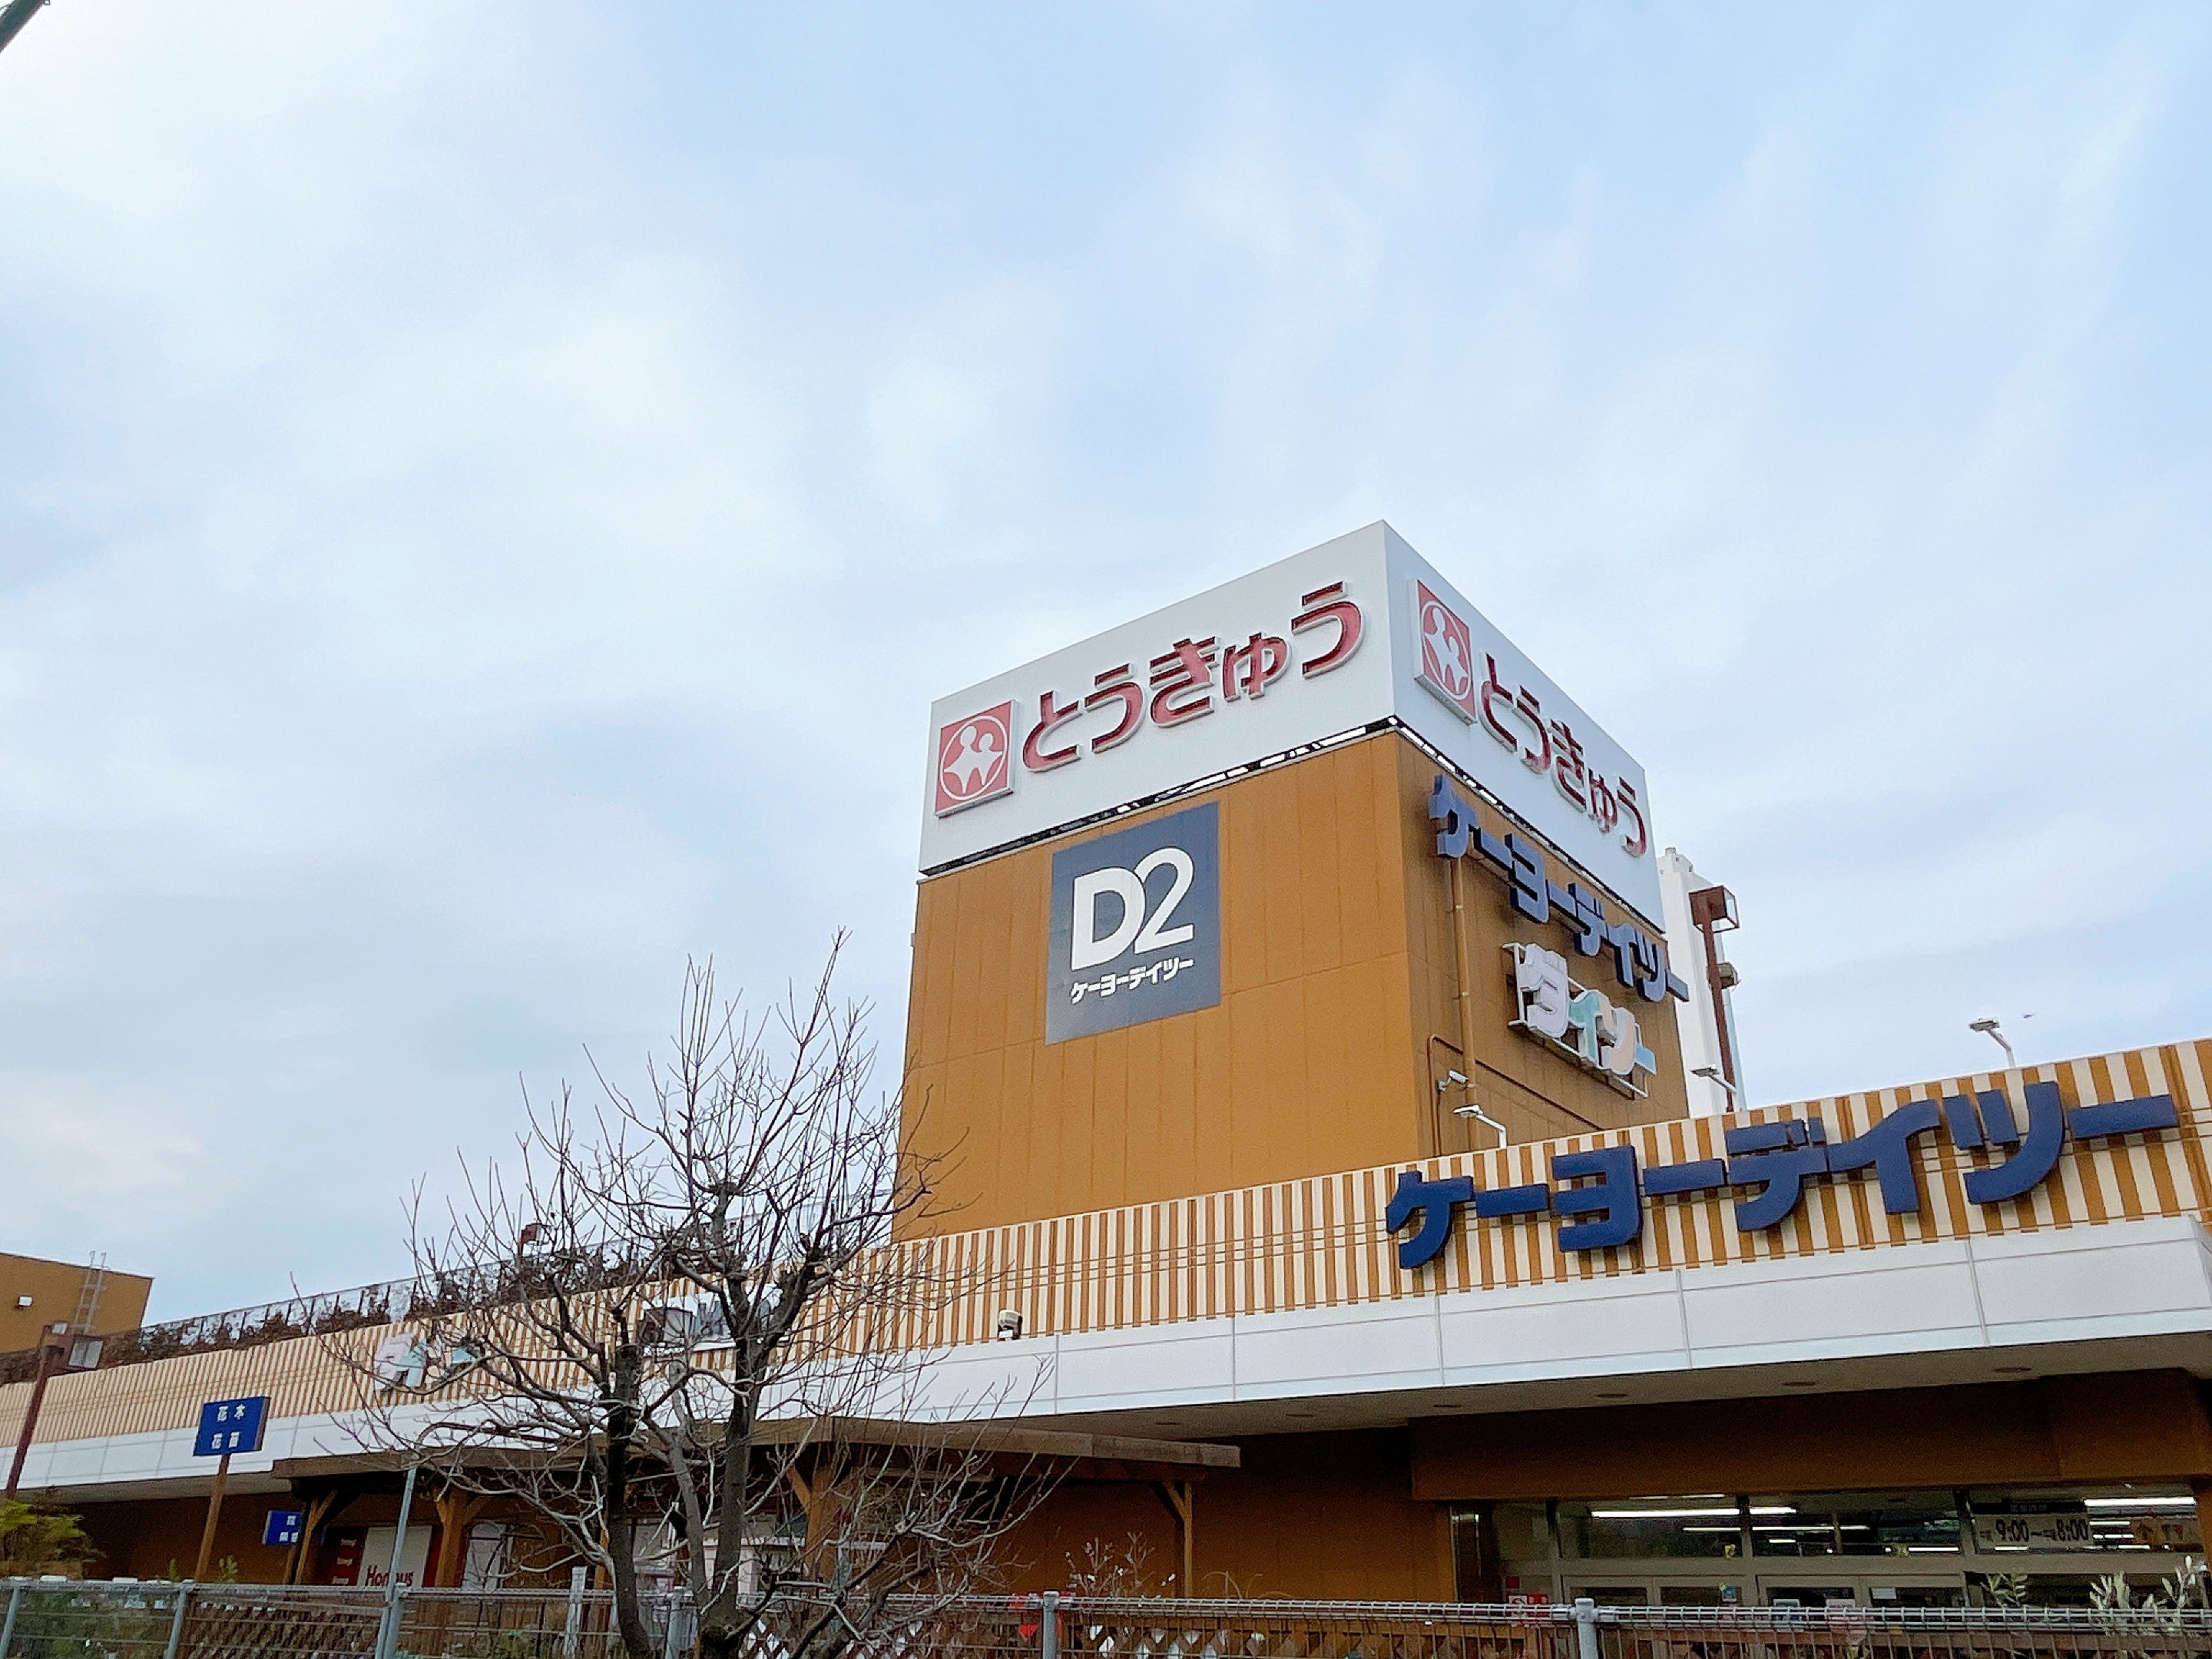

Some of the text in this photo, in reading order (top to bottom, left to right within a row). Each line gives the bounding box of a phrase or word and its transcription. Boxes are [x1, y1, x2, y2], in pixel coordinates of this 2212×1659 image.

[1022, 581, 1365, 772] とうきゅう
[1481, 654, 1646, 856] とうきゅう
[1070, 957, 1194, 1005] ケーヨーデイツー
[1071, 846, 1195, 971] D2
[1429, 774, 1688, 1003] ケーヨーデイツー
[1518, 943, 1657, 1075] ダイソー
[1386, 1080, 2178, 1269] ケーヨーデイツー
